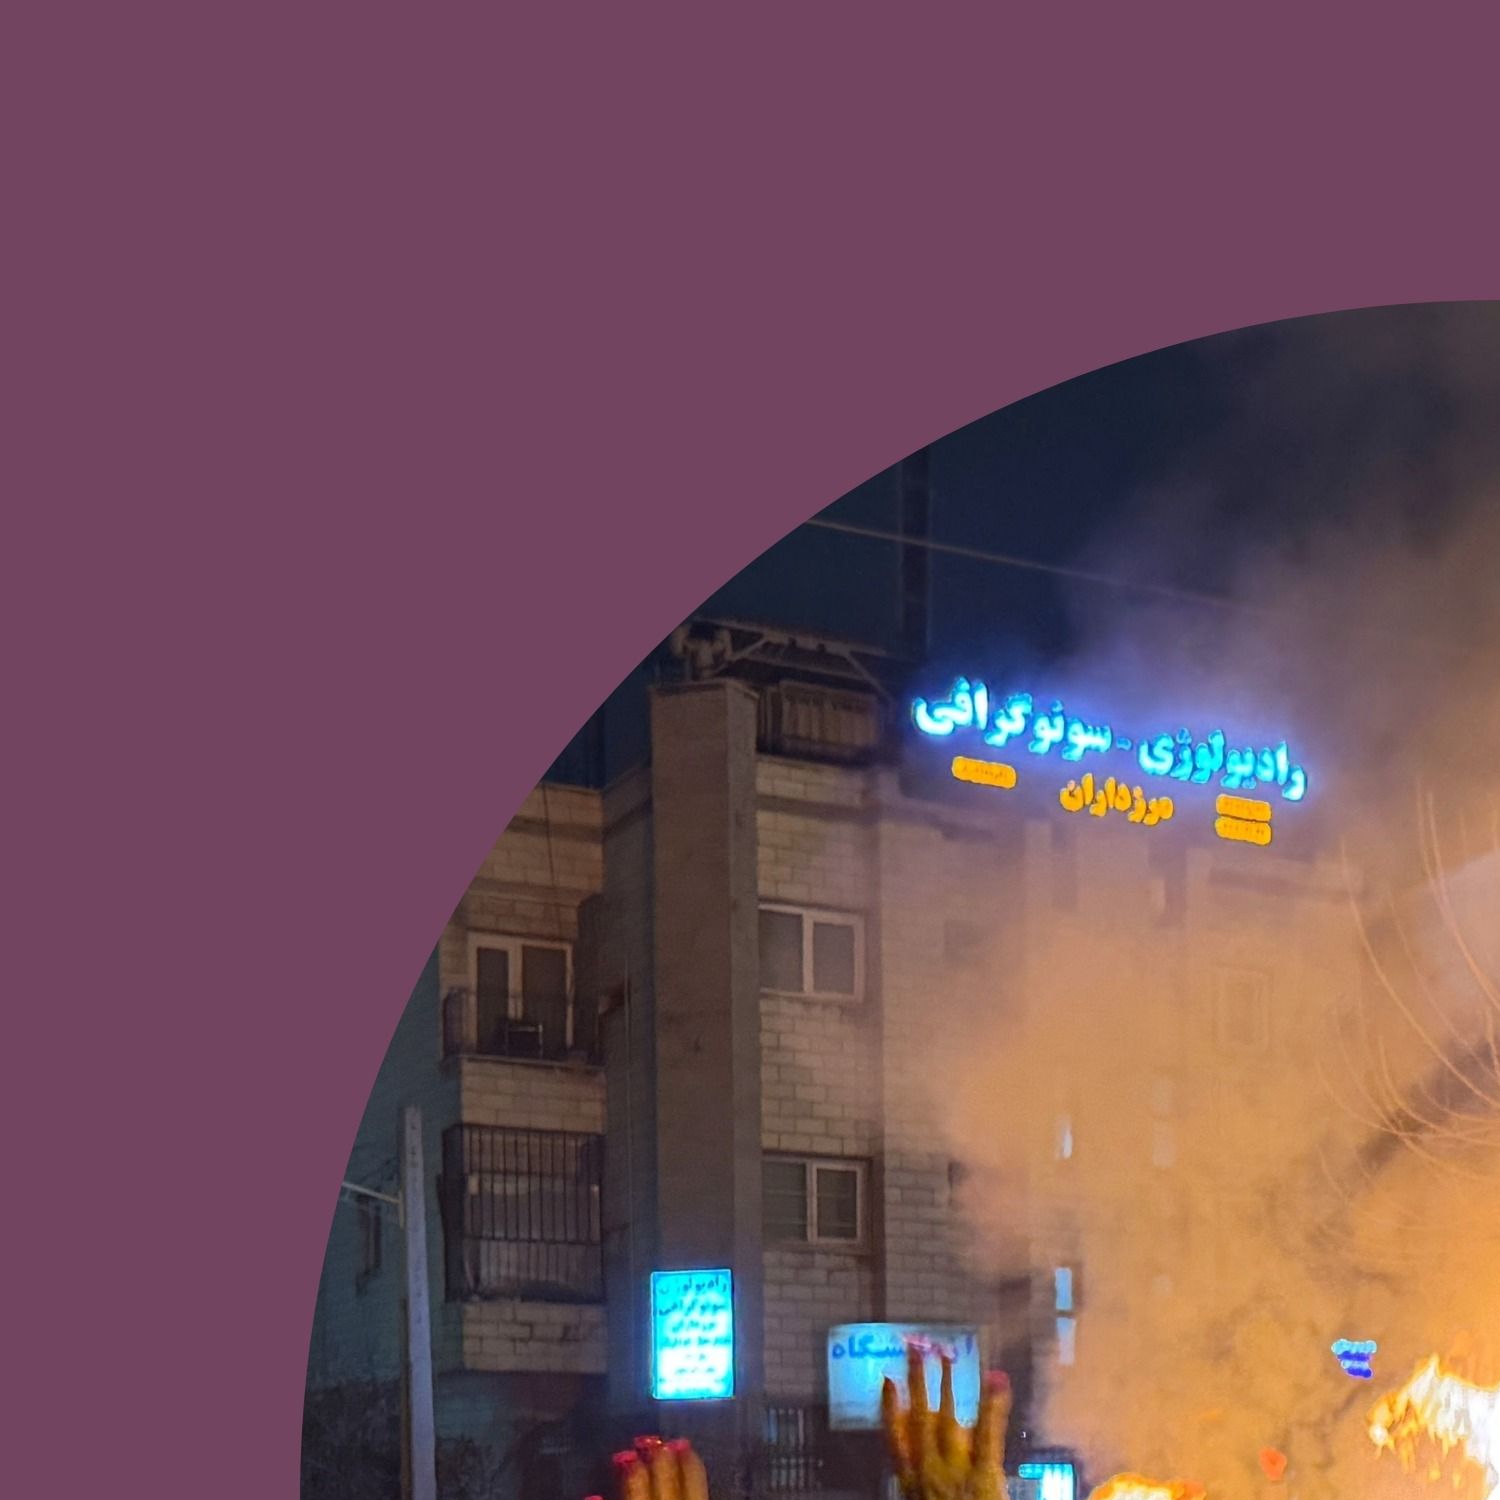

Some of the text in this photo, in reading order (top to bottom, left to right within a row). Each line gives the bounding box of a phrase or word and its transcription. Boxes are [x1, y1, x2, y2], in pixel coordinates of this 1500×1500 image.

[912, 676, 1114, 762] سونوگرافی
[1059, 772, 1174, 826] مرزداران
[1138, 727, 1308, 801] رادیولوژی
